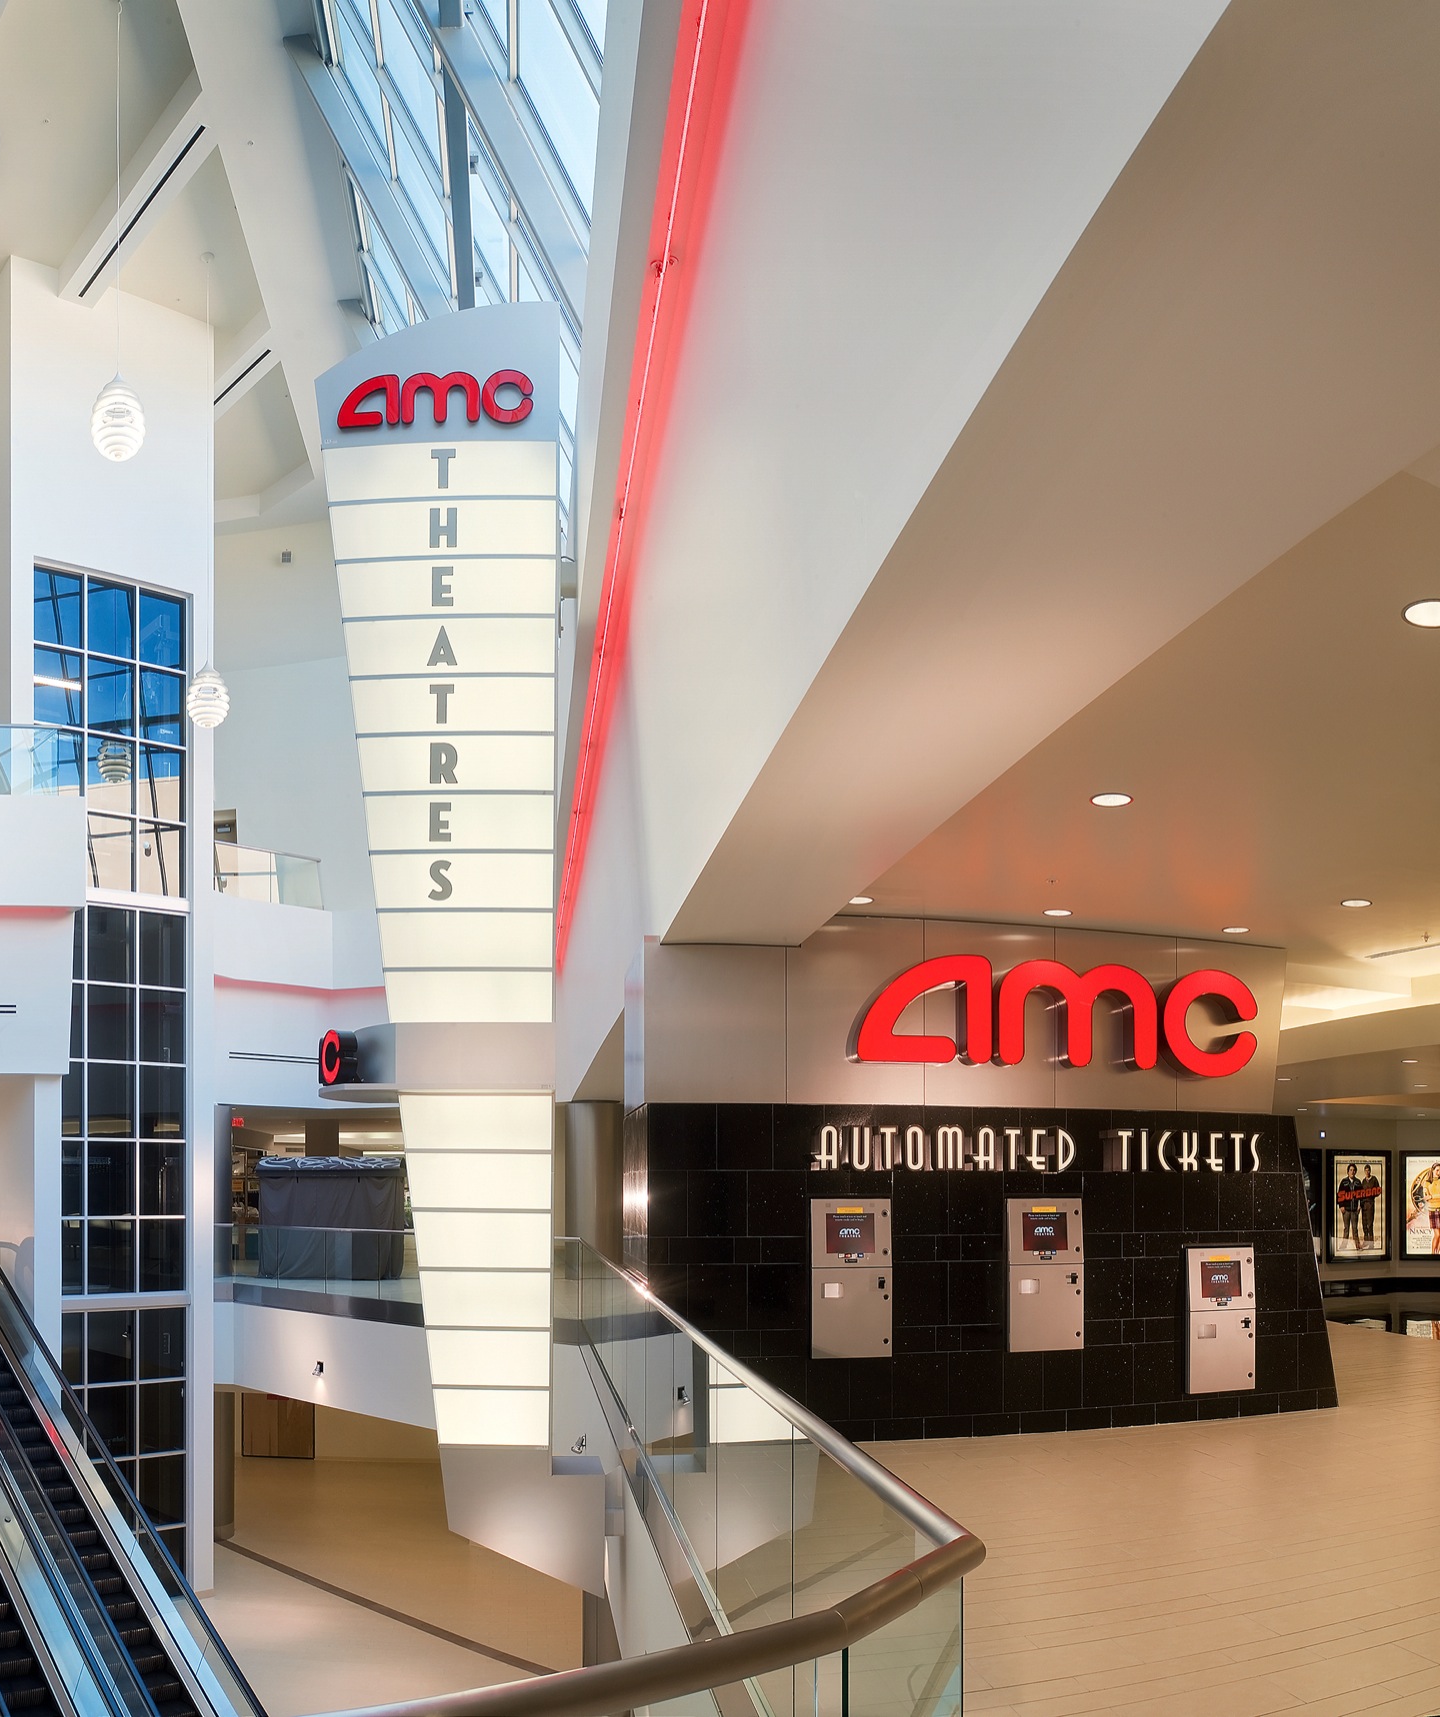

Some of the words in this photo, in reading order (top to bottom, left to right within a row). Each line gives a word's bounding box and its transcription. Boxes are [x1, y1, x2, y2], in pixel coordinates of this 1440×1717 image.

[427, 448, 458, 902] THEATRES
[814, 1125, 1077, 1171] AUTOMATED
[1117, 1129, 1260, 1172] TICKETS
